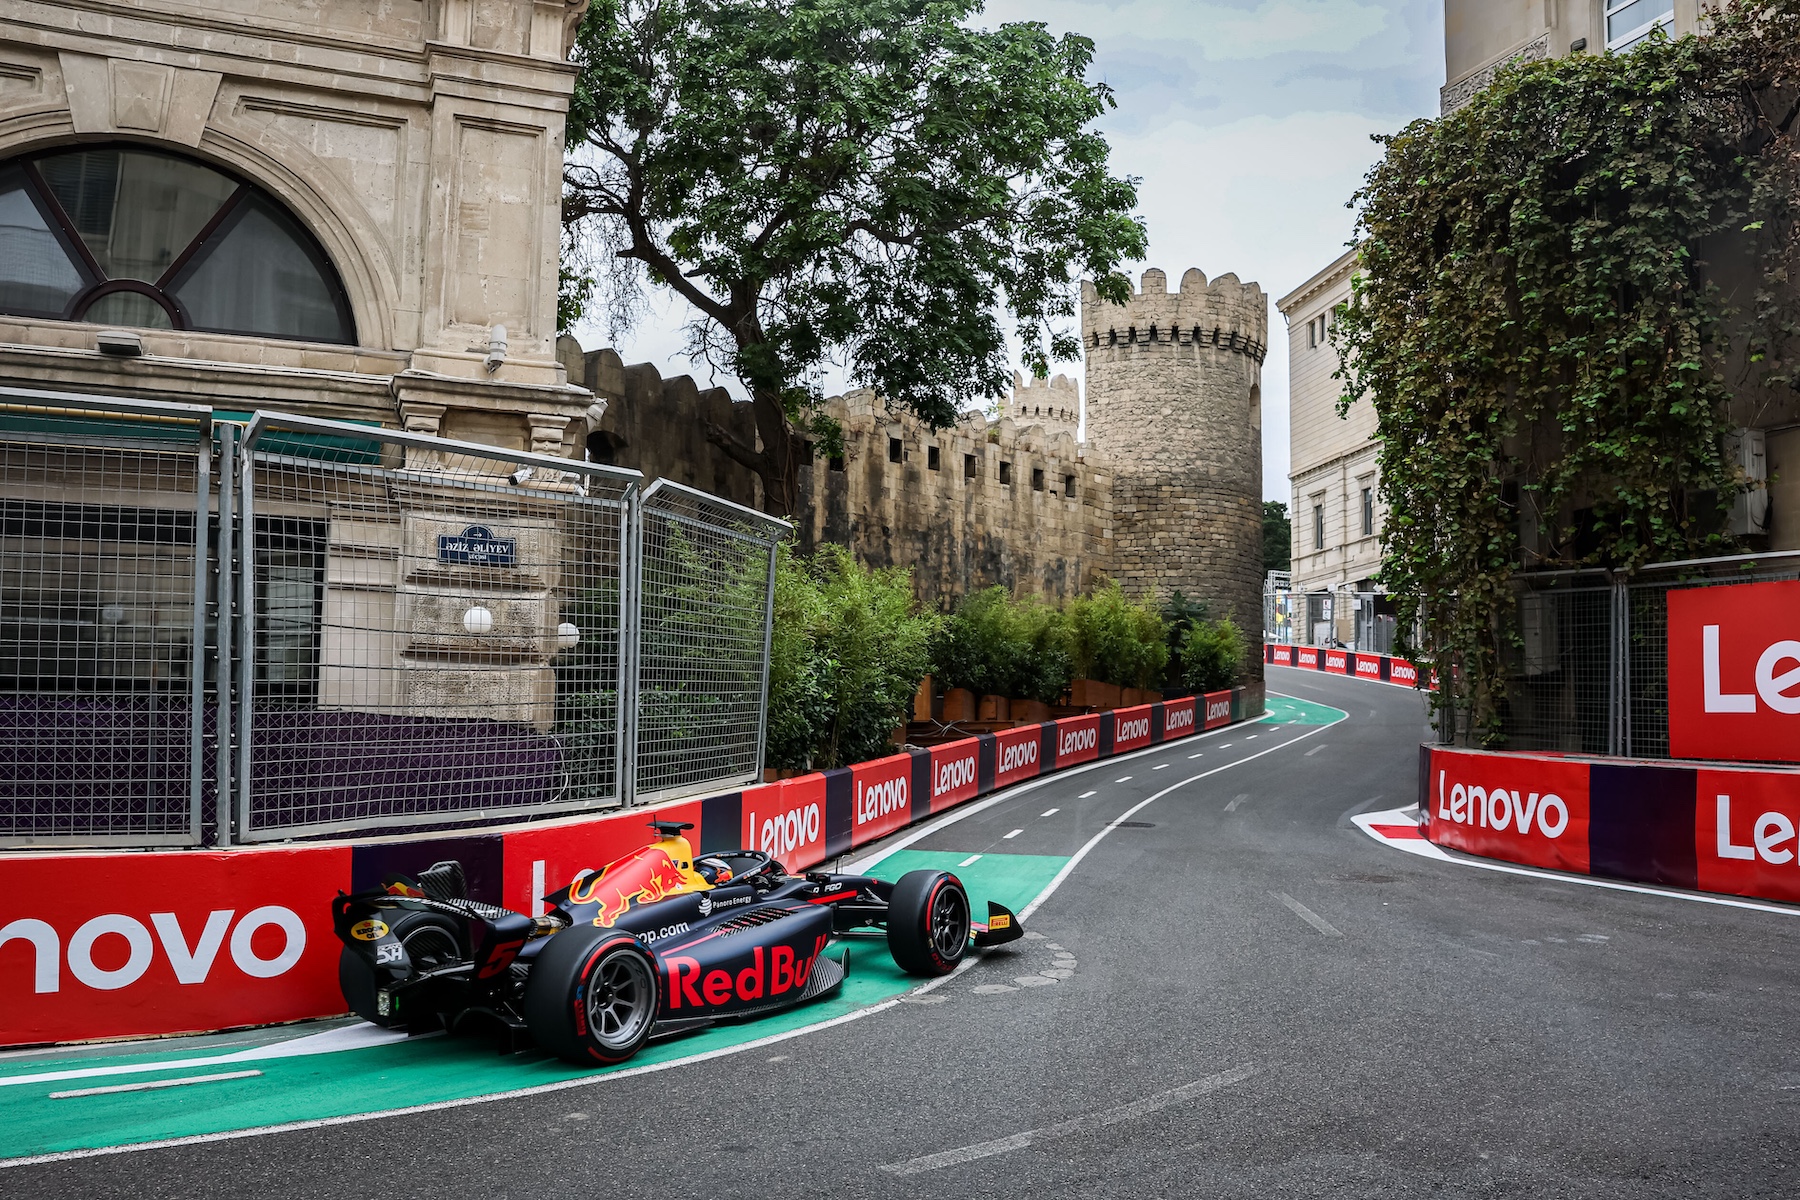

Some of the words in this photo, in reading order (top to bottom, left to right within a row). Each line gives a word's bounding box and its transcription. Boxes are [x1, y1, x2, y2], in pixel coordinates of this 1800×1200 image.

[1273, 647, 1290, 661] Lenovo
[1298, 650, 1317, 665] Lenovo
[1325, 652, 1345, 669] Lenovo
[1356, 657, 1379, 674] Lenovo
[1391, 662, 1416, 680] Lenovo
[1166, 707, 1193, 731] Lenovo
[1206, 700, 1230, 721] Lenovo
[1059, 727, 1096, 756] Lenovo
[1116, 717, 1149, 743] Lenovo
[998, 740, 1037, 774] Lenovo
[934, 756, 975, 797] Lenovo
[857, 776, 907, 826] Lenovo
[1438, 769, 1569, 838] Lenovo
[1716, 794, 1800, 867] Le
[733, 896, 752, 906] Energy
[636, 921, 690, 944] op.com
[664, 945, 765, 1009] Red
[770, 933, 827, 996] Bull
